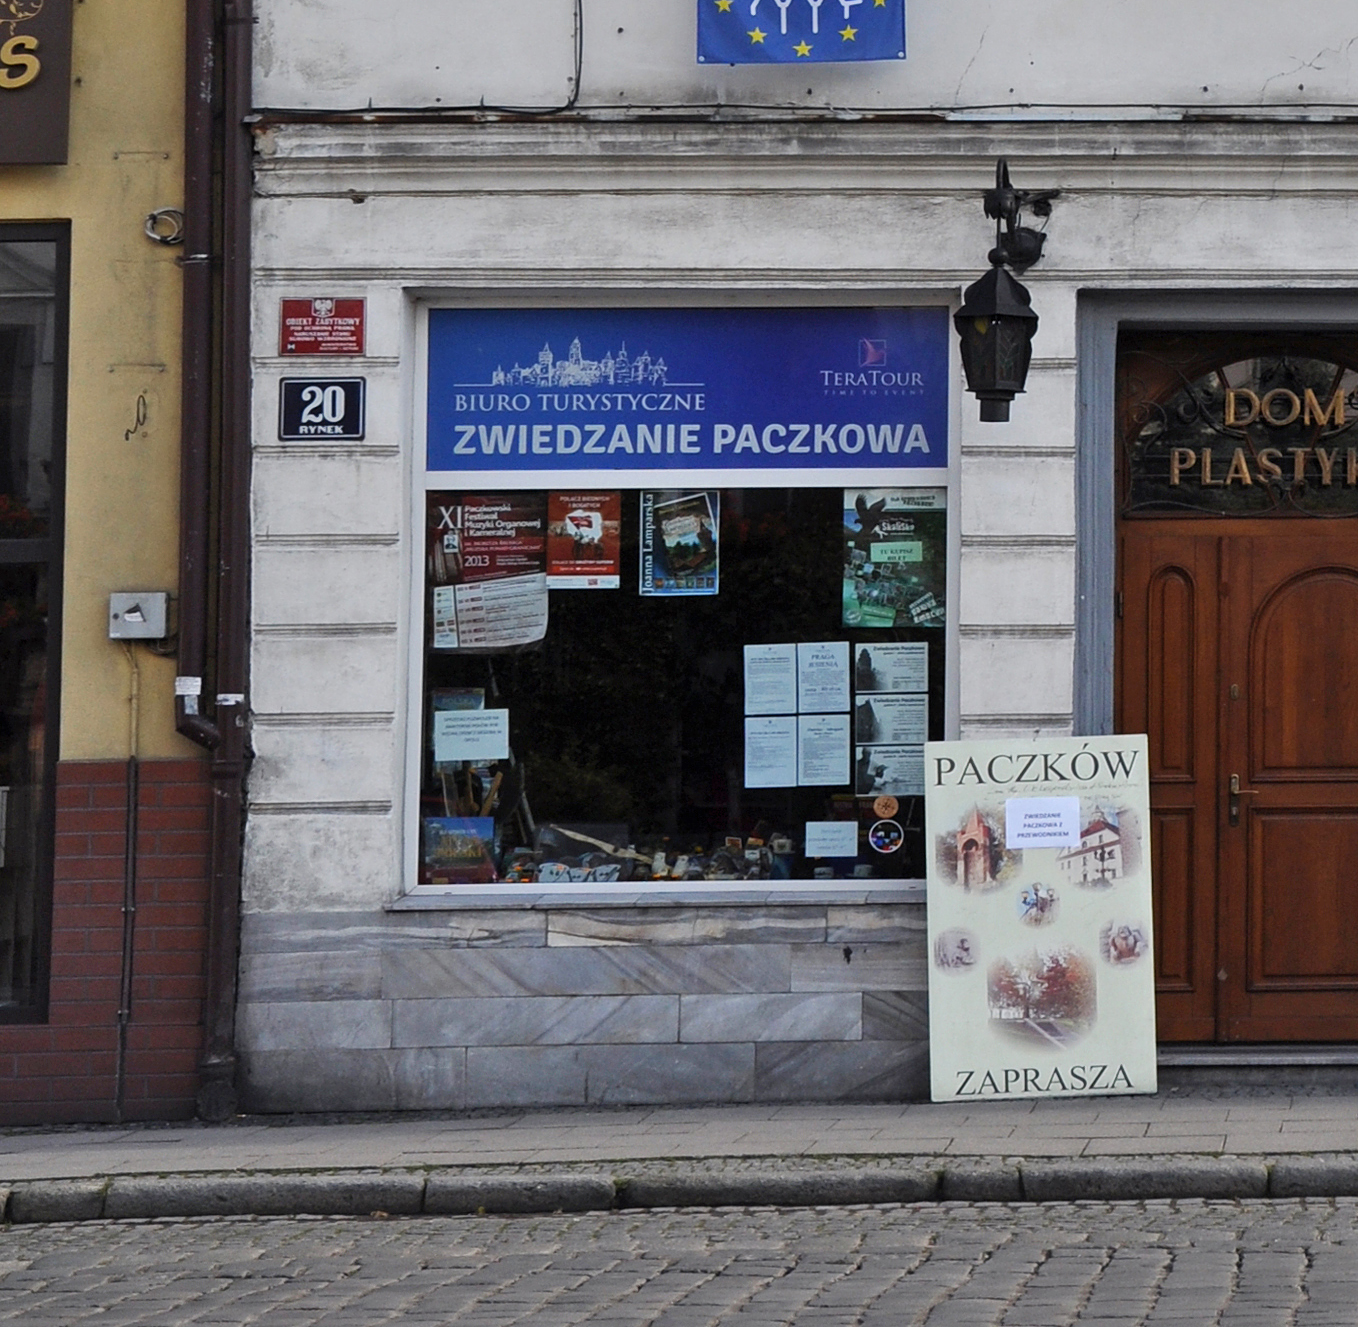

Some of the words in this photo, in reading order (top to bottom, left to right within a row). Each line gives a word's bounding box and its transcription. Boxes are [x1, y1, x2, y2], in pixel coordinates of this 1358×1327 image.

[301, 386, 345, 423] 20
[454, 394, 531, 412] BIURO
[540, 393, 706, 412] TURYSTYCZNE
[1224, 387, 1346, 426] DOM
[299, 425, 344, 434] RYNEK
[453, 424, 701, 454] ZWIEDZANIE
[713, 423, 931, 454] PACZKOWA
[438, 505, 463, 529] XI
[464, 503, 511, 512] Paczkowski
[464, 512, 498, 520] Festiwal
[464, 521, 494, 530] Muzyki
[495, 519, 541, 529] Organowej
[469, 529, 516, 537] Kameralnej
[642, 494, 656, 552] Lamparska
[464, 555, 490, 566] 2013
[642, 554, 654, 592] Joanna
[933, 743, 1140, 786] PACZKÓW
[955, 1063, 1135, 1097] ZAPRASZA
